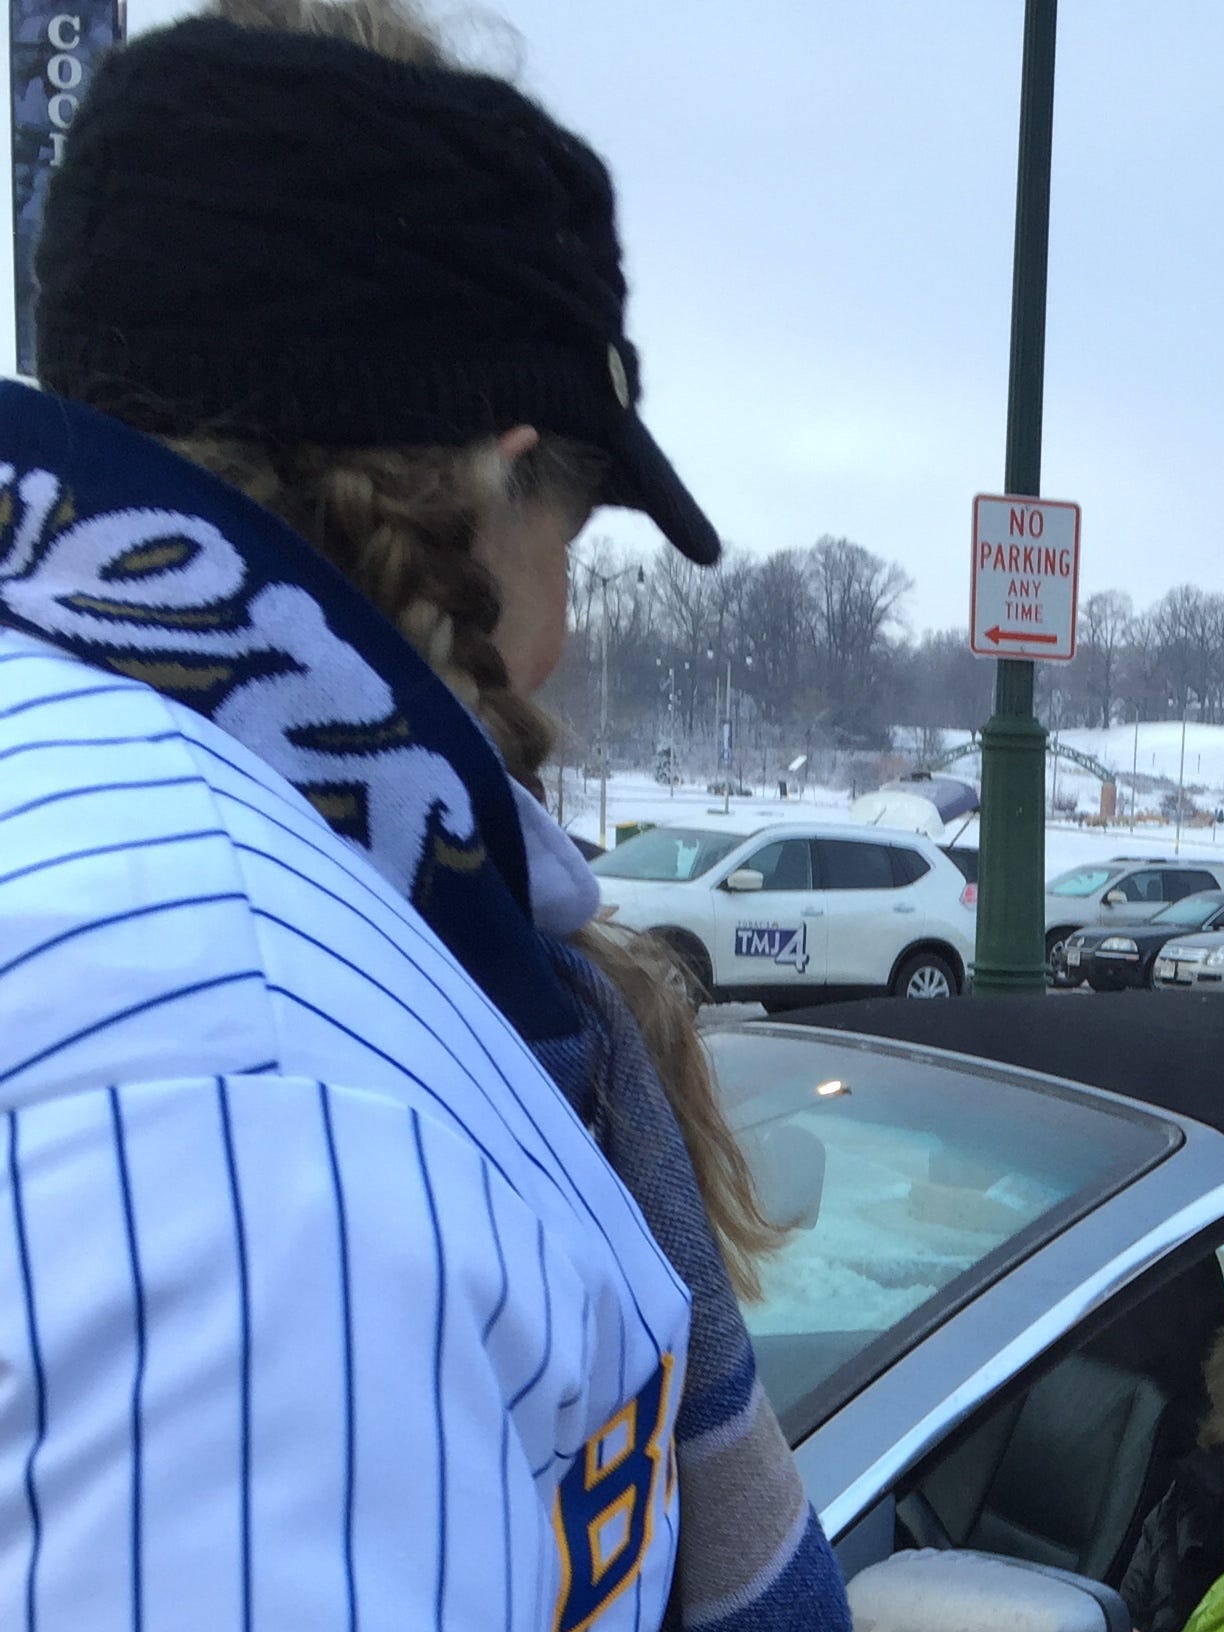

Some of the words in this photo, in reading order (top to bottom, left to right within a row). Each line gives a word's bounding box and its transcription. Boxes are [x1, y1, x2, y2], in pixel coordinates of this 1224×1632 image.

[1009, 507, 1044, 538] NO
[980, 541, 1071, 578] PARKING
[1008, 578, 1042, 599] ANY
[1005, 600, 1043, 624] TIME
